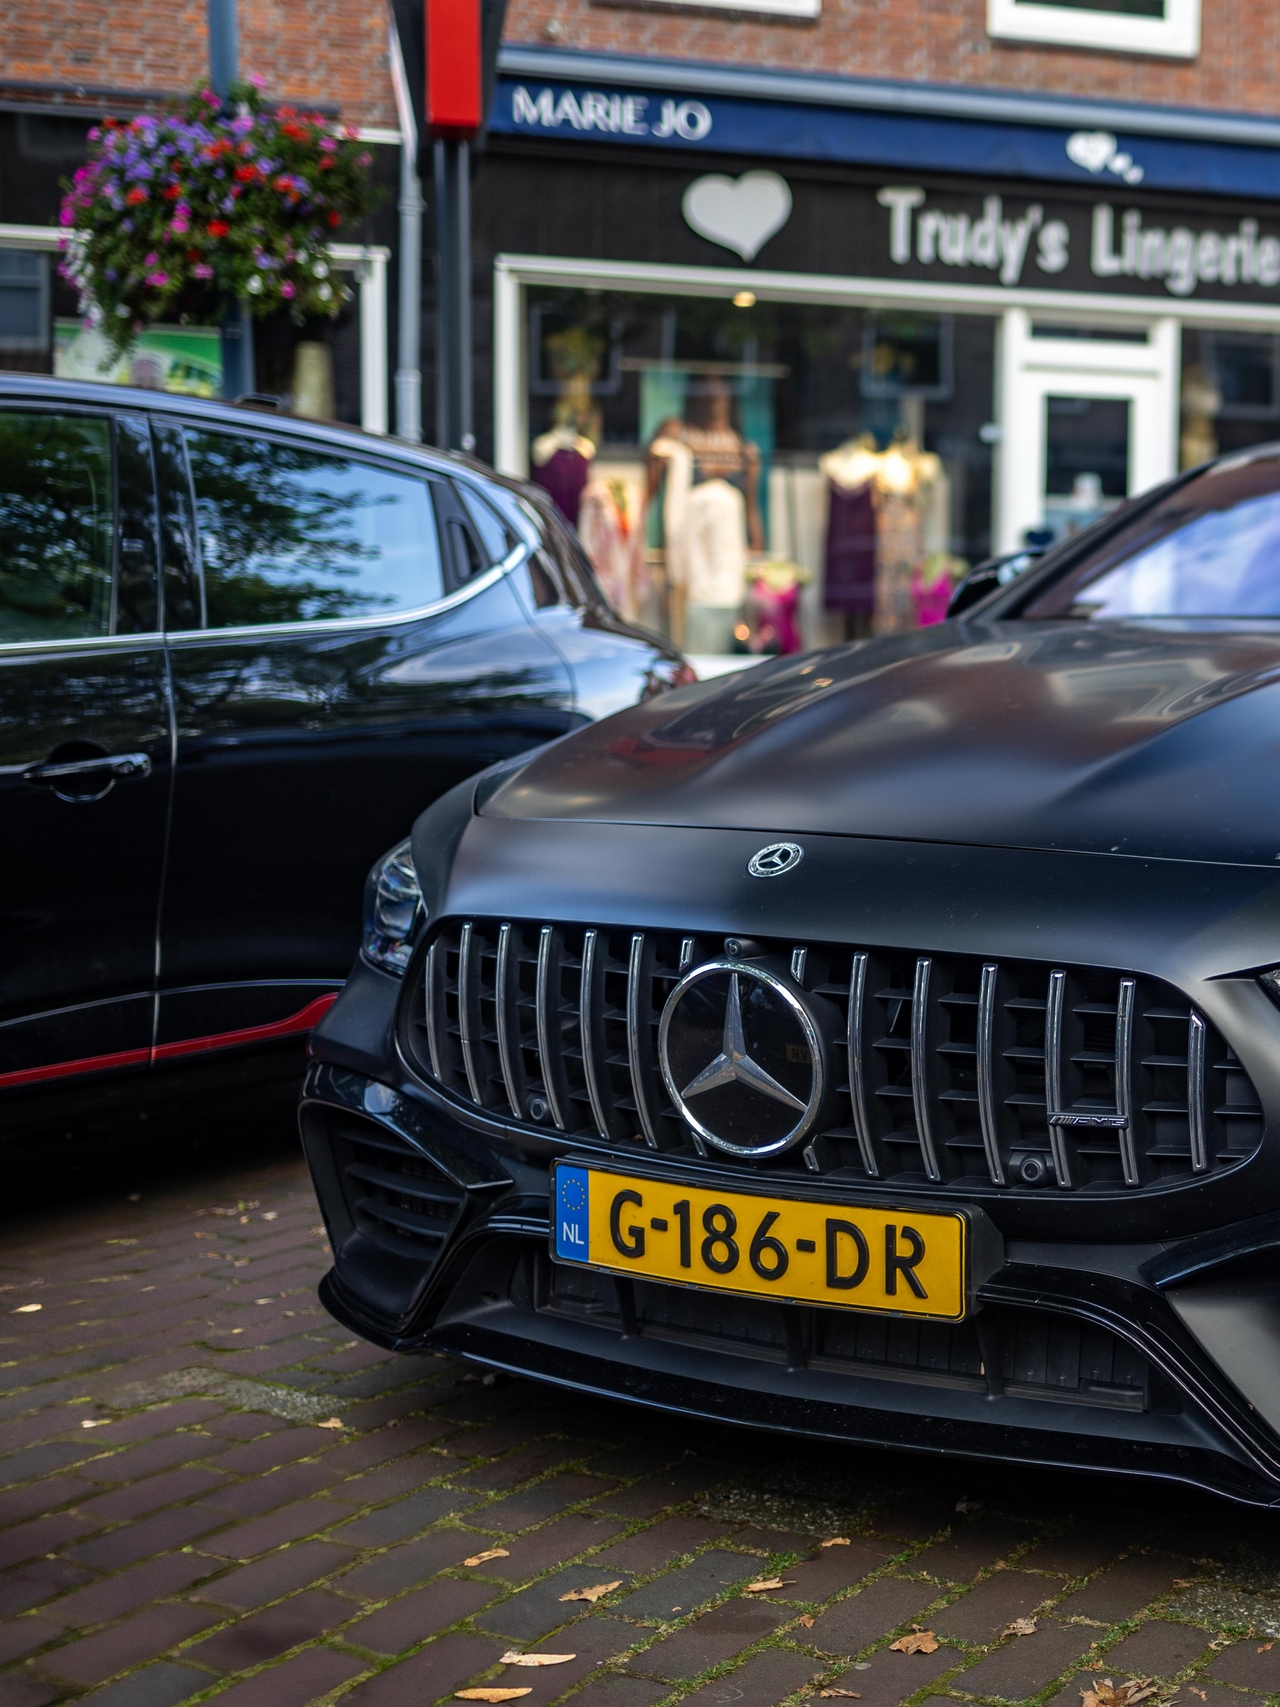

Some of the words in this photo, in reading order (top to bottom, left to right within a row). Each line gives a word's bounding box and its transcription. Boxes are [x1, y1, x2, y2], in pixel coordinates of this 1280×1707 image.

[512, 86, 650, 136] MARIE
[651, 98, 713, 141] JO
[877, 186, 1070, 286] Trudy's
[562, 1222, 585, 1245] NL
[609, 1188, 929, 1299] G-186-DR
